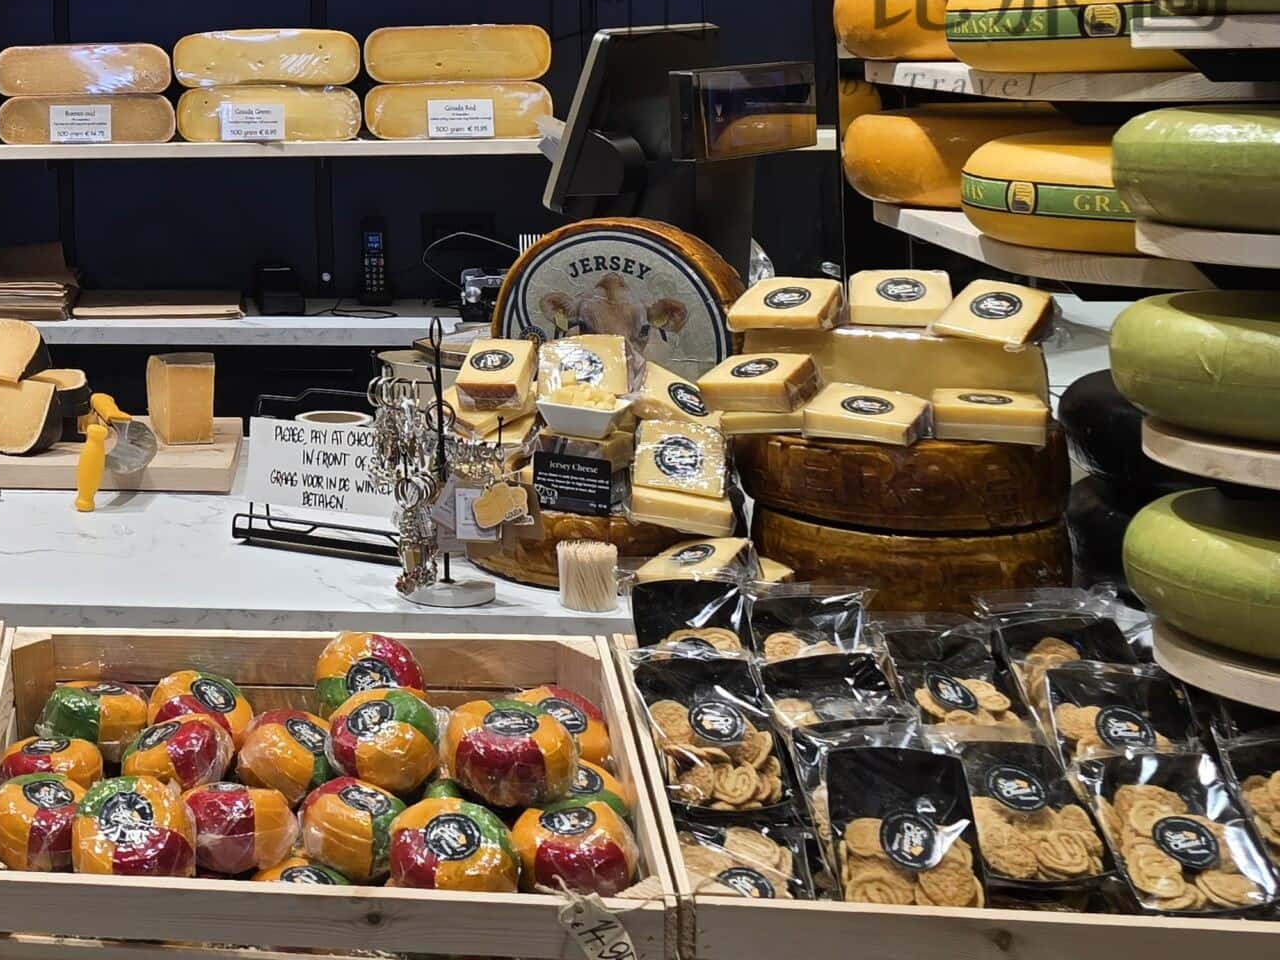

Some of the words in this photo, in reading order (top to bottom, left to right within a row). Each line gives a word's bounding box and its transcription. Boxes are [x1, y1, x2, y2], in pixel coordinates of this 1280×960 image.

[569, 256, 651, 280] JERSEY
[310, 429, 329, 443] PAY
[331, 430, 344, 446] AT
[302, 450, 315, 465] IN
[316, 452, 351, 468] FRONT
[354, 456, 368, 472] OF
[549, 461, 571, 471] Jersey
[572, 463, 599, 474] Cheese
[270, 469, 298, 487] GRAAG
